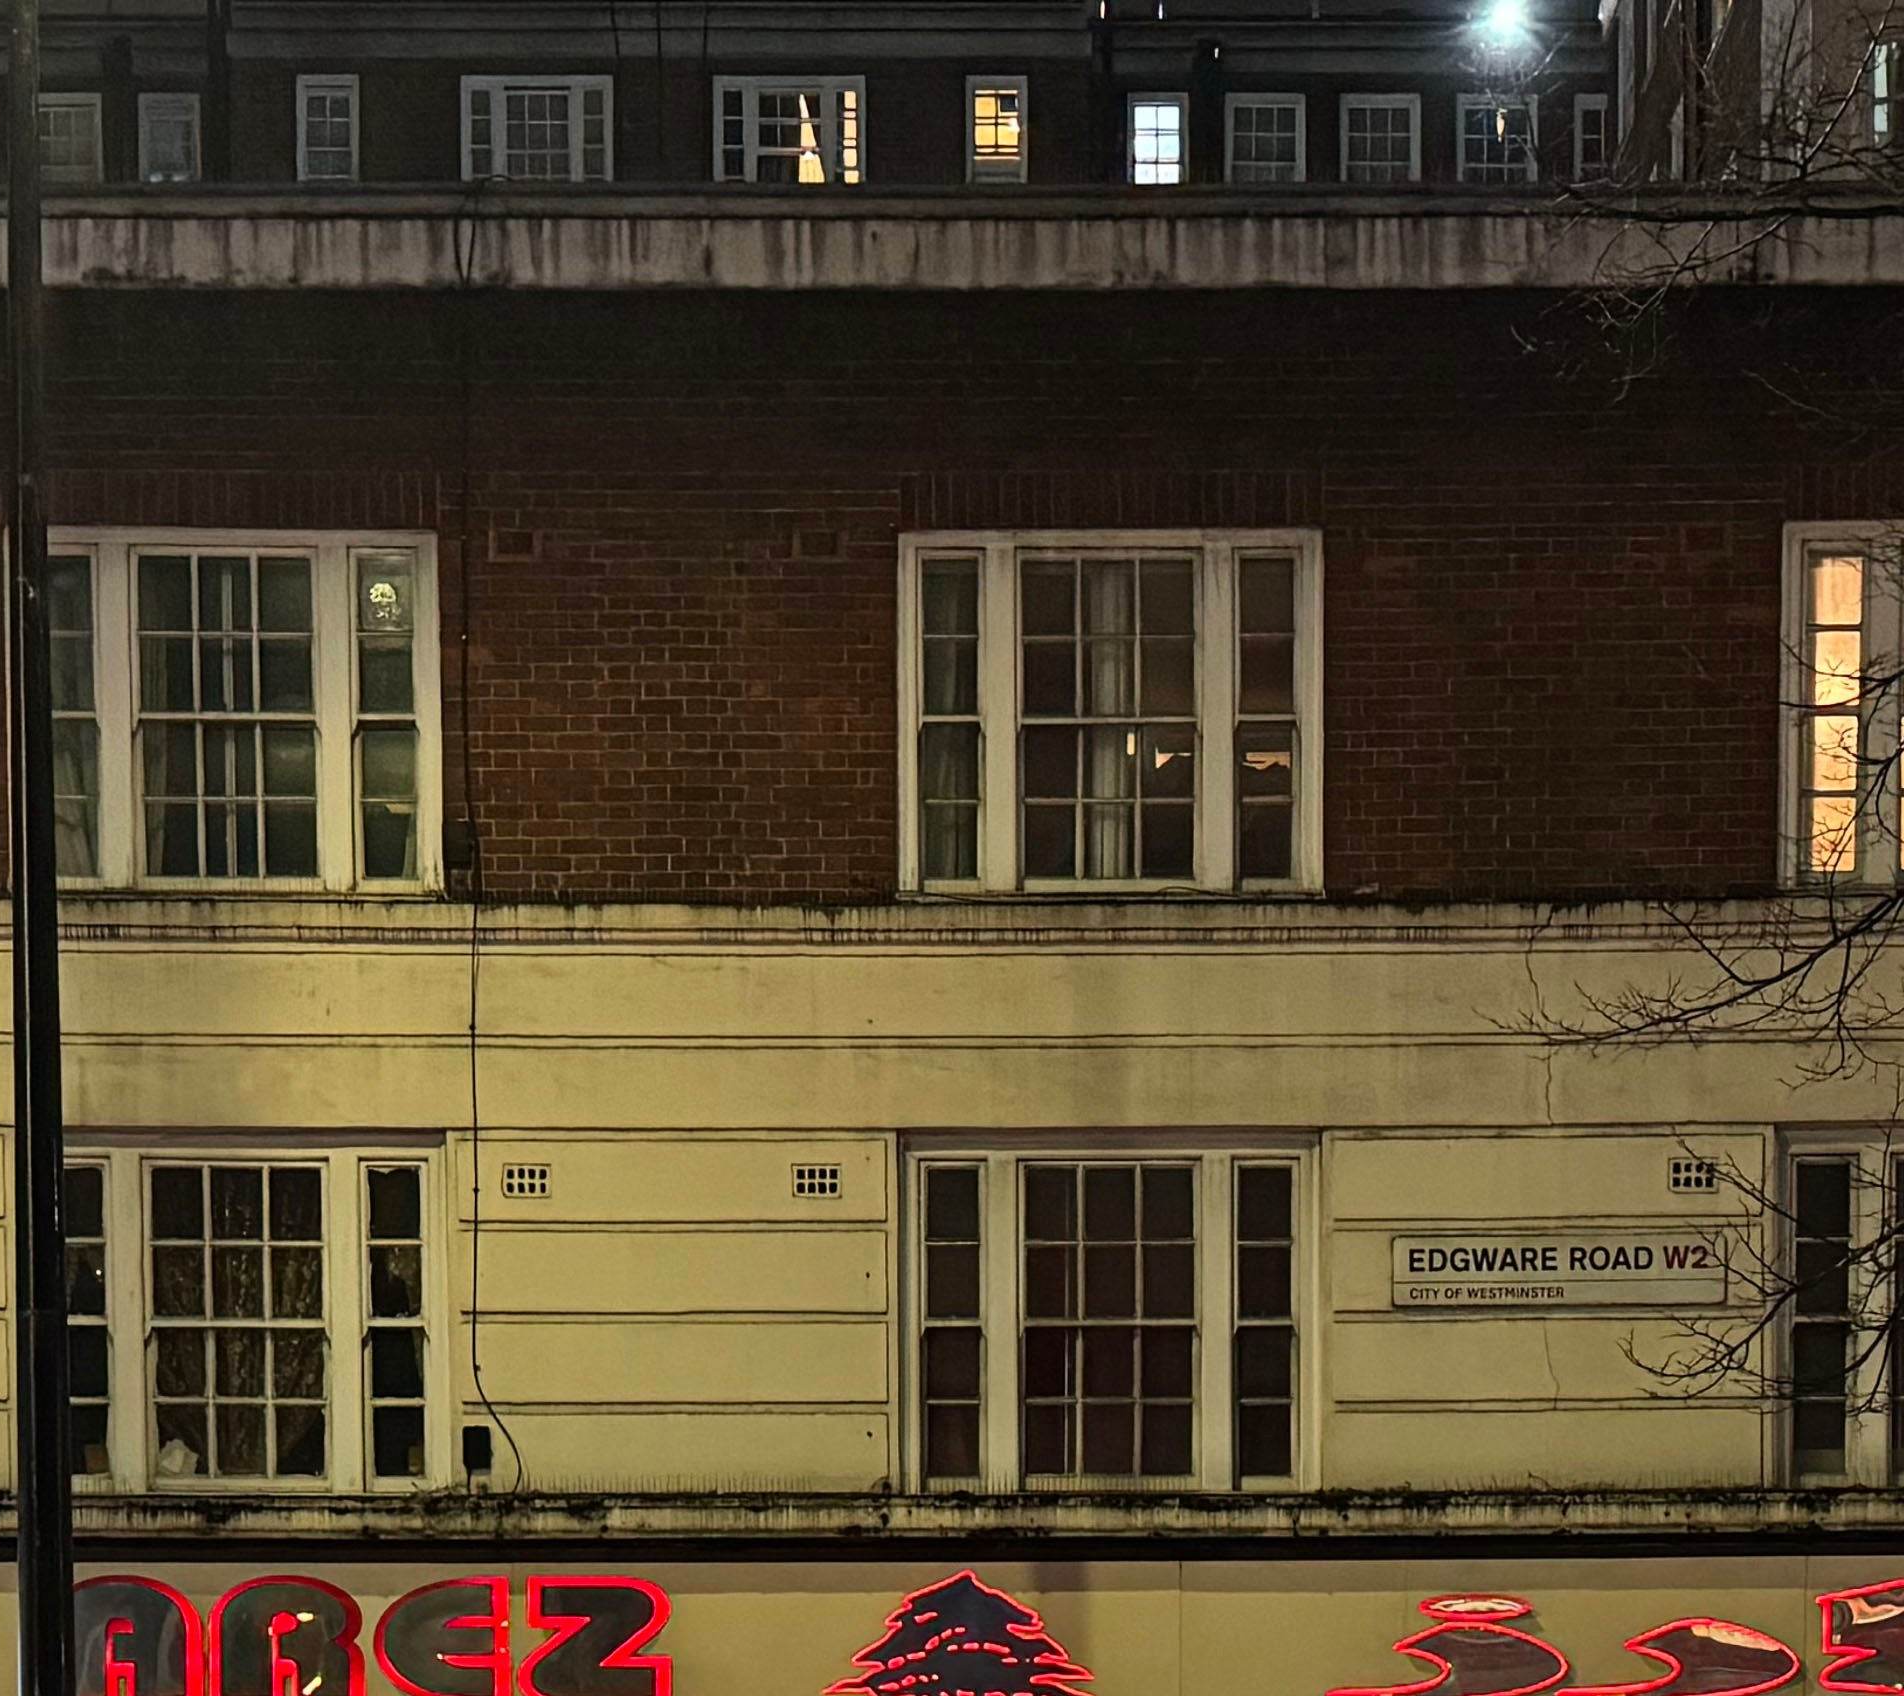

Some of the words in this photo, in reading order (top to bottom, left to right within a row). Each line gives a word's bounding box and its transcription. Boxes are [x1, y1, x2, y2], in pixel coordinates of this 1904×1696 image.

[1409, 1246, 1558, 1273] EDGWARE
[1569, 1245, 1653, 1271] ROAD
[1663, 1245, 1708, 1269] W2
[1409, 1287, 1440, 1300] CITY
[1444, 1287, 1462, 1299] OF
[1467, 1285, 1564, 1299] WESTMINSTER
